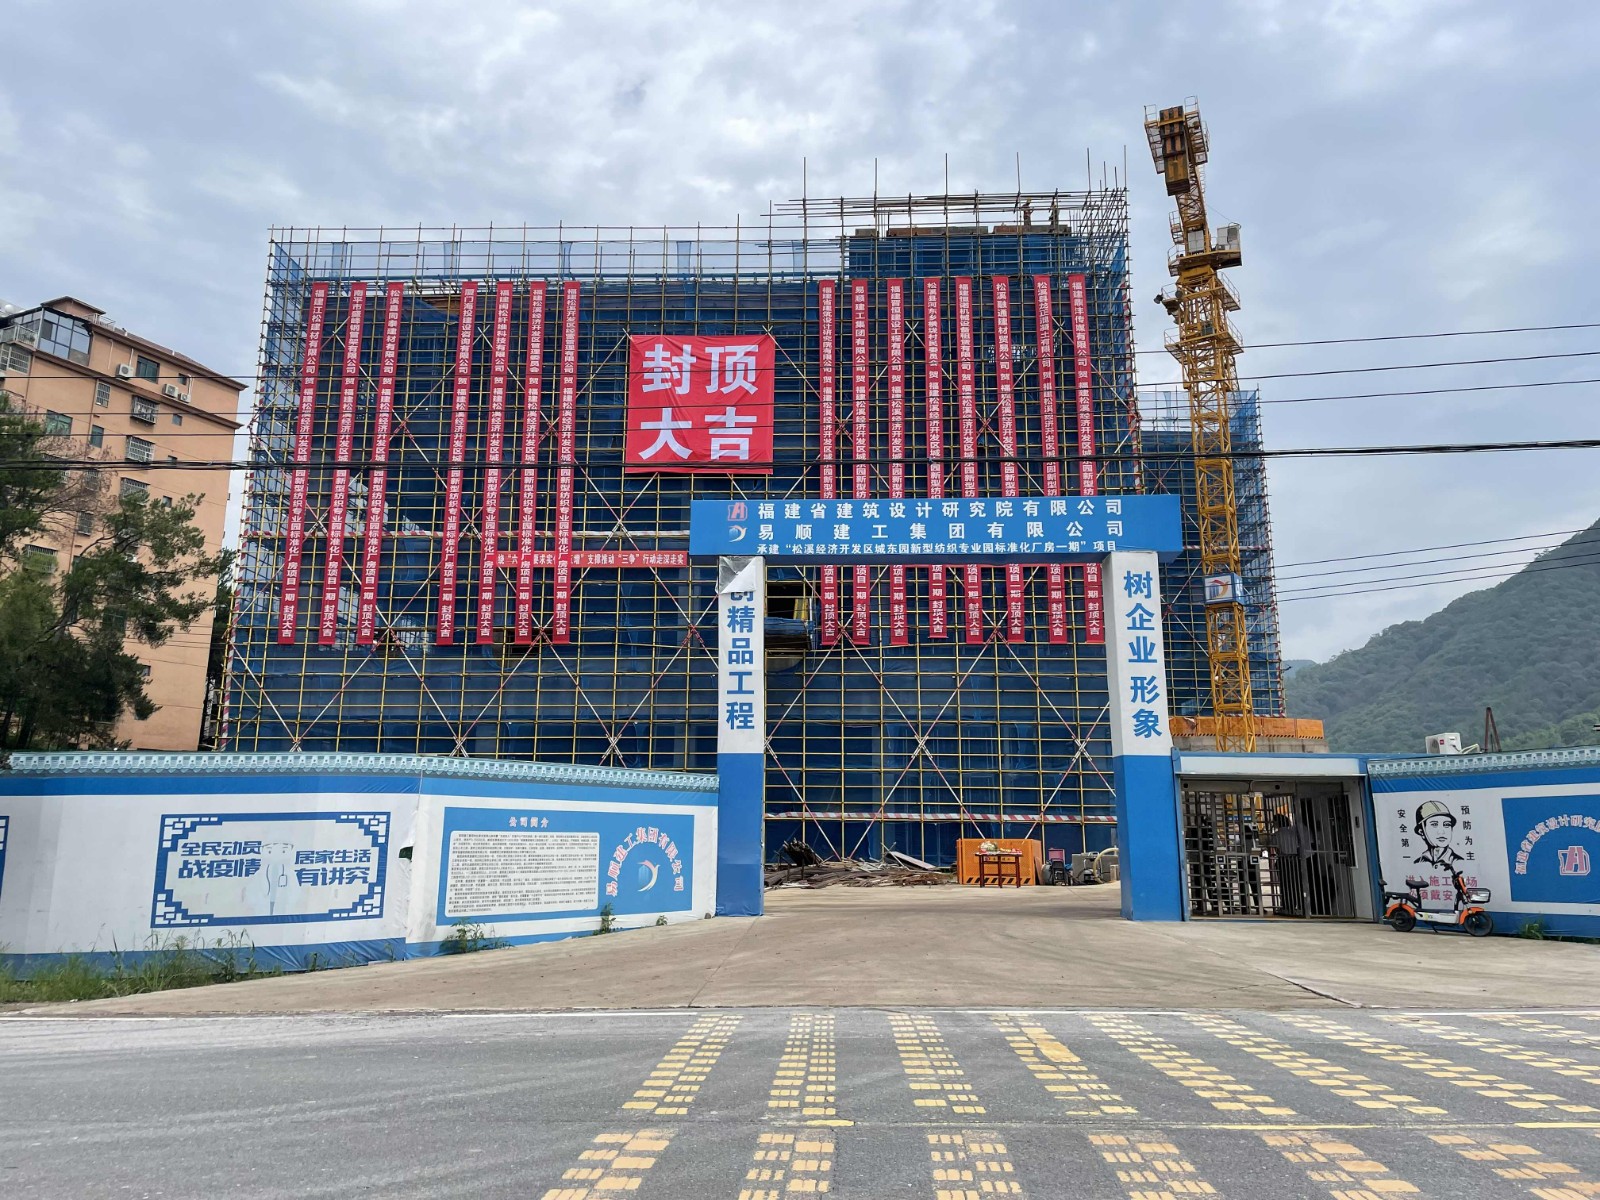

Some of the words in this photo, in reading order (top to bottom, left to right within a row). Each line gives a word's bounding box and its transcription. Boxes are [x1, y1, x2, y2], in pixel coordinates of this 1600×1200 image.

[822, 287, 833, 372] 福建省建筑设计研究院有限公司
[854, 286, 866, 371] 易顺建工集团有限公司
[642, 343, 759, 395] 封顶
[638, 406, 757, 460] 大吉
[284, 388, 314, 600] 福建松溪经济开发区城园新型纺织专业园标准化厂房项目一期
[325, 389, 354, 600] 福建松溪经济开发区城园新型纺织专业园标准化厂房项目一期
[363, 388, 392, 599] 福建松溪经济开发区城园新型纺织专业园标准化厂房项目一期
[442, 388, 471, 600] 福建松溪经济开发区城园新型纺织专业园标准化厂房项目一期
[481, 388, 504, 599] 福建松溪经济开发区城园新型纺织专业园标准化厂房项目一期
[518, 388, 539, 599] 福建松溪经济开发区城园新型纺织专业园标准化厂房项目一期
[556, 388, 574, 598] 福建松溪经济开发区城园新型纺织专业园标准化厂房项目一期
[758, 499, 1122, 520] 福建省建筑设计研究院有限公司
[758, 521, 1123, 540] 易顺建工集团有限公司
[281, 605, 295, 636] 封顶大吉
[322, 604, 336, 636] 封顶大吉
[361, 604, 377, 635] 封顶大吉
[440, 605, 453, 636] 封顶大吉
[480, 604, 492, 635] 封顶大吉
[518, 604, 533, 635] 封顶大吉
[555, 603, 567, 634] 封顶大吉
[824, 604, 836, 636] 封顶大吉
[855, 604, 867, 636] 封顶大吉
[893, 604, 908, 636] 封顶大吉
[932, 600, 944, 632] 封顶大吉
[968, 603, 980, 635] 封顶大吉
[1010, 602, 1022, 634] 封顶大吉
[1051, 603, 1064, 635] 封顶大吉
[1088, 602, 1100, 634] 封顶大吉
[1123, 570, 1163, 738] 树企业形象
[181, 841, 262, 856] 全民动员
[1397, 809, 1411, 859] 安全第一
[1460, 805, 1475, 861] 预防为主
[178, 858, 262, 879] 战疫情
[294, 849, 371, 865] 居家生活
[294, 866, 370, 886] 有讲究
